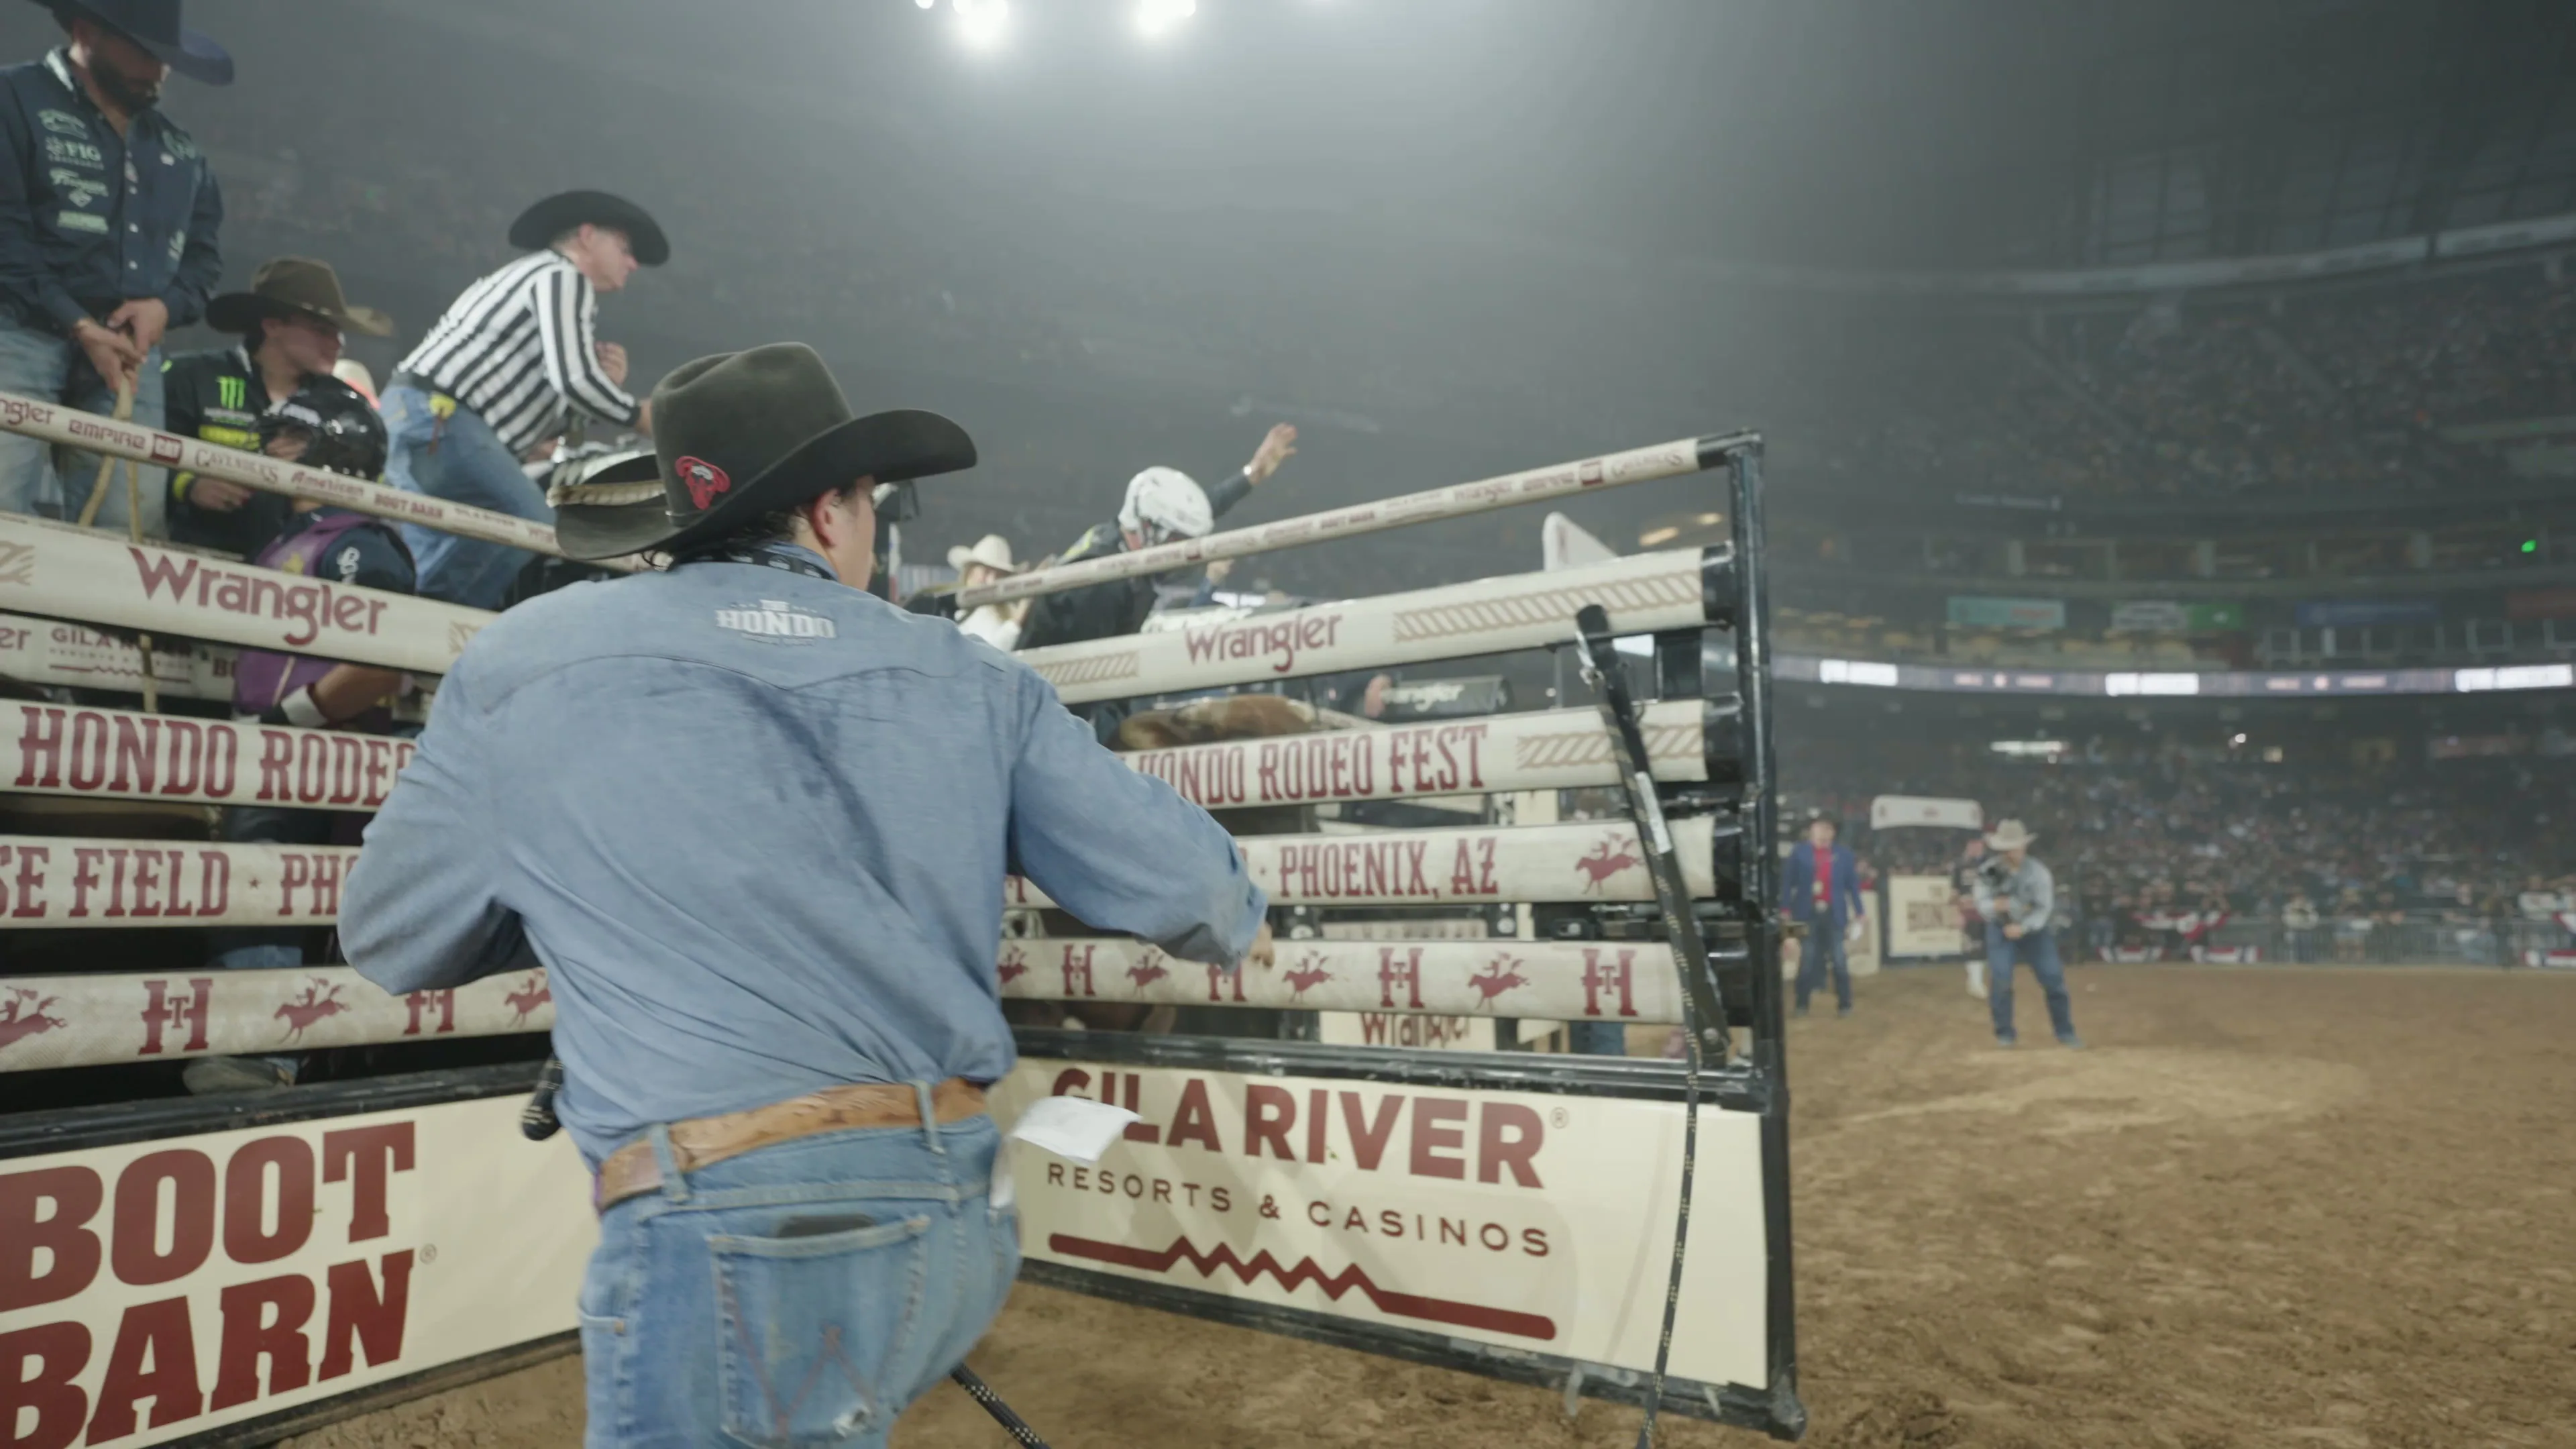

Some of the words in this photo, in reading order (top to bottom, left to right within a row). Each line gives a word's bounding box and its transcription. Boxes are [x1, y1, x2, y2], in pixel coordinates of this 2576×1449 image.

[127, 546, 388, 646] Wrangler
[714, 610, 837, 638] HONDO
[1184, 613, 1342, 674] Wrangler
[14, 706, 237, 798] HONDO
[1258, 734, 1374, 801] RODEO
[1389, 724, 1488, 794] FEST
[68, 848, 230, 917] FIELD
[277, 853, 359, 916] PH
[1451, 837, 1498, 895] AZ
[1244, 1084, 1545, 1189] RIVER
[0, 1120, 415, 1313] BOOT
[1048, 1163, 1232, 1212] RESORTS
[1259, 1194, 1281, 1220] &
[1308, 1200, 1550, 1257] CASINOS
[0, 1248, 415, 1449] BARN
